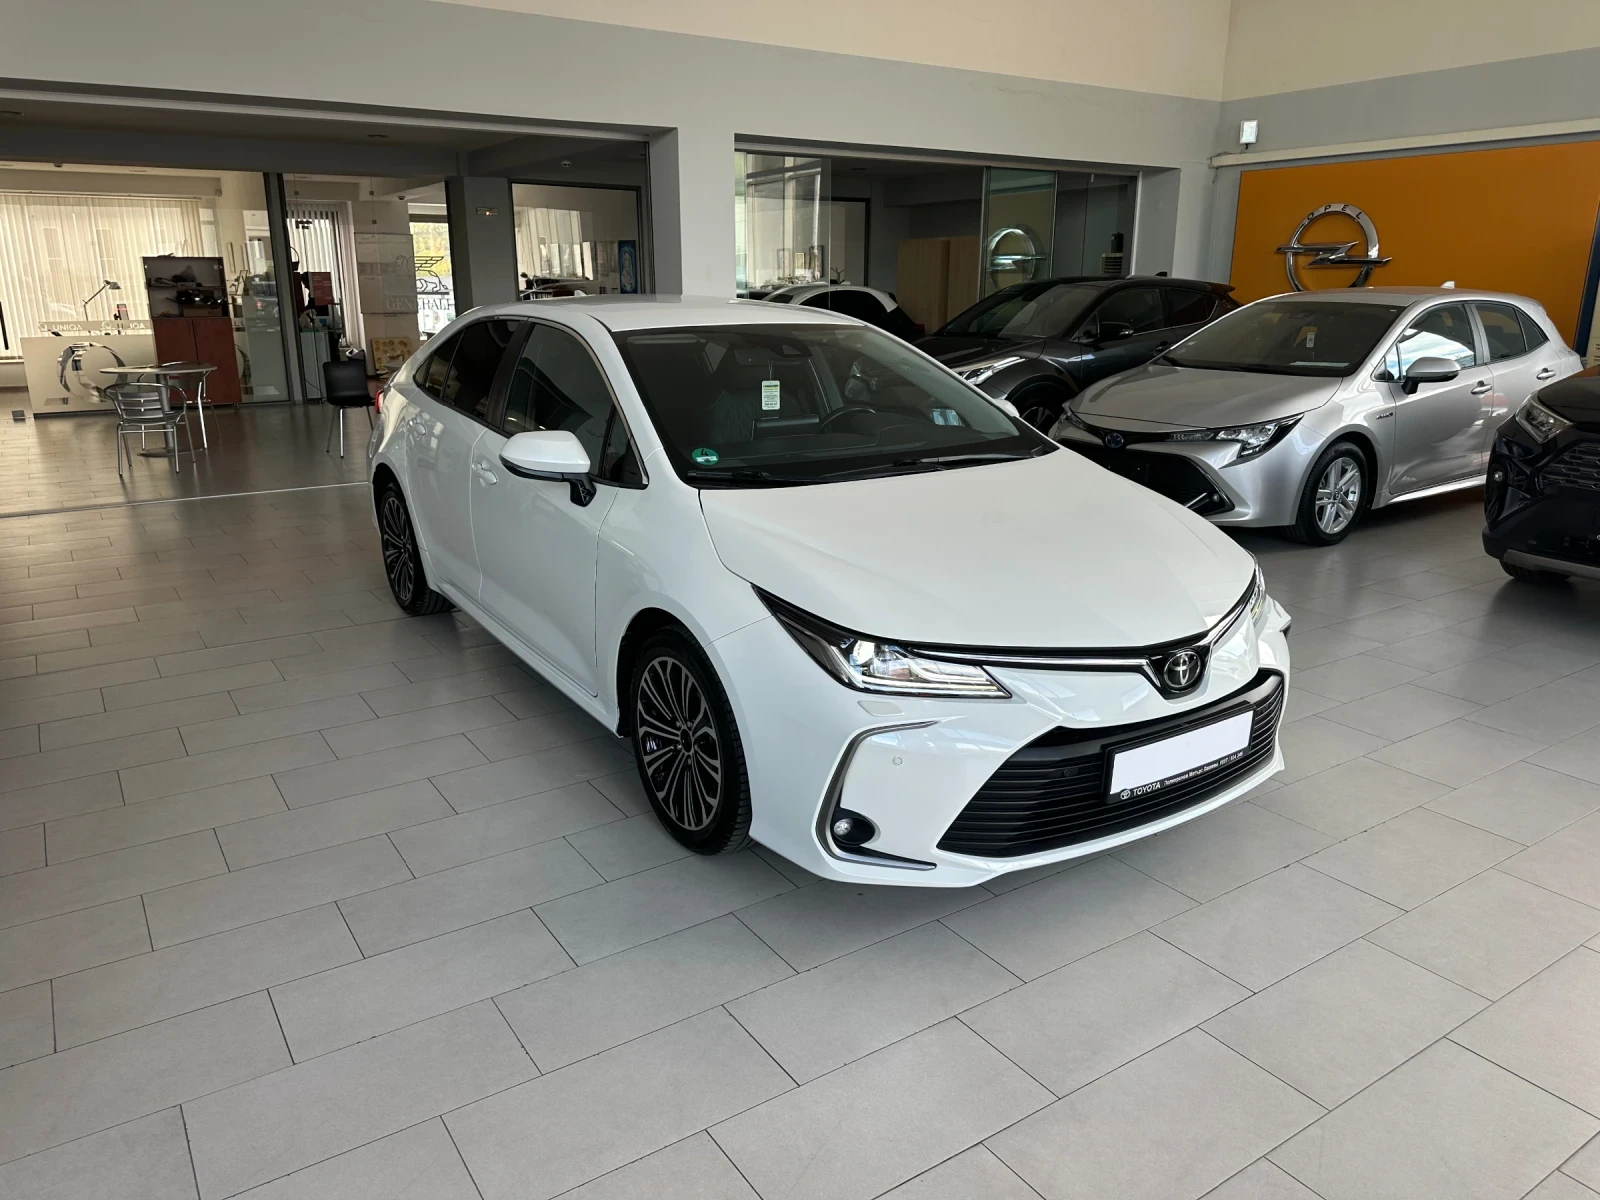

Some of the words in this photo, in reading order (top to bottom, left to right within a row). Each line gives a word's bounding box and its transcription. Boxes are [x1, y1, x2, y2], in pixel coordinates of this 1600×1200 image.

[1307, 204, 1362, 220] OPEL
[700, 448, 709, 457] 4
[1132, 782, 1161, 796] TOYOTA
